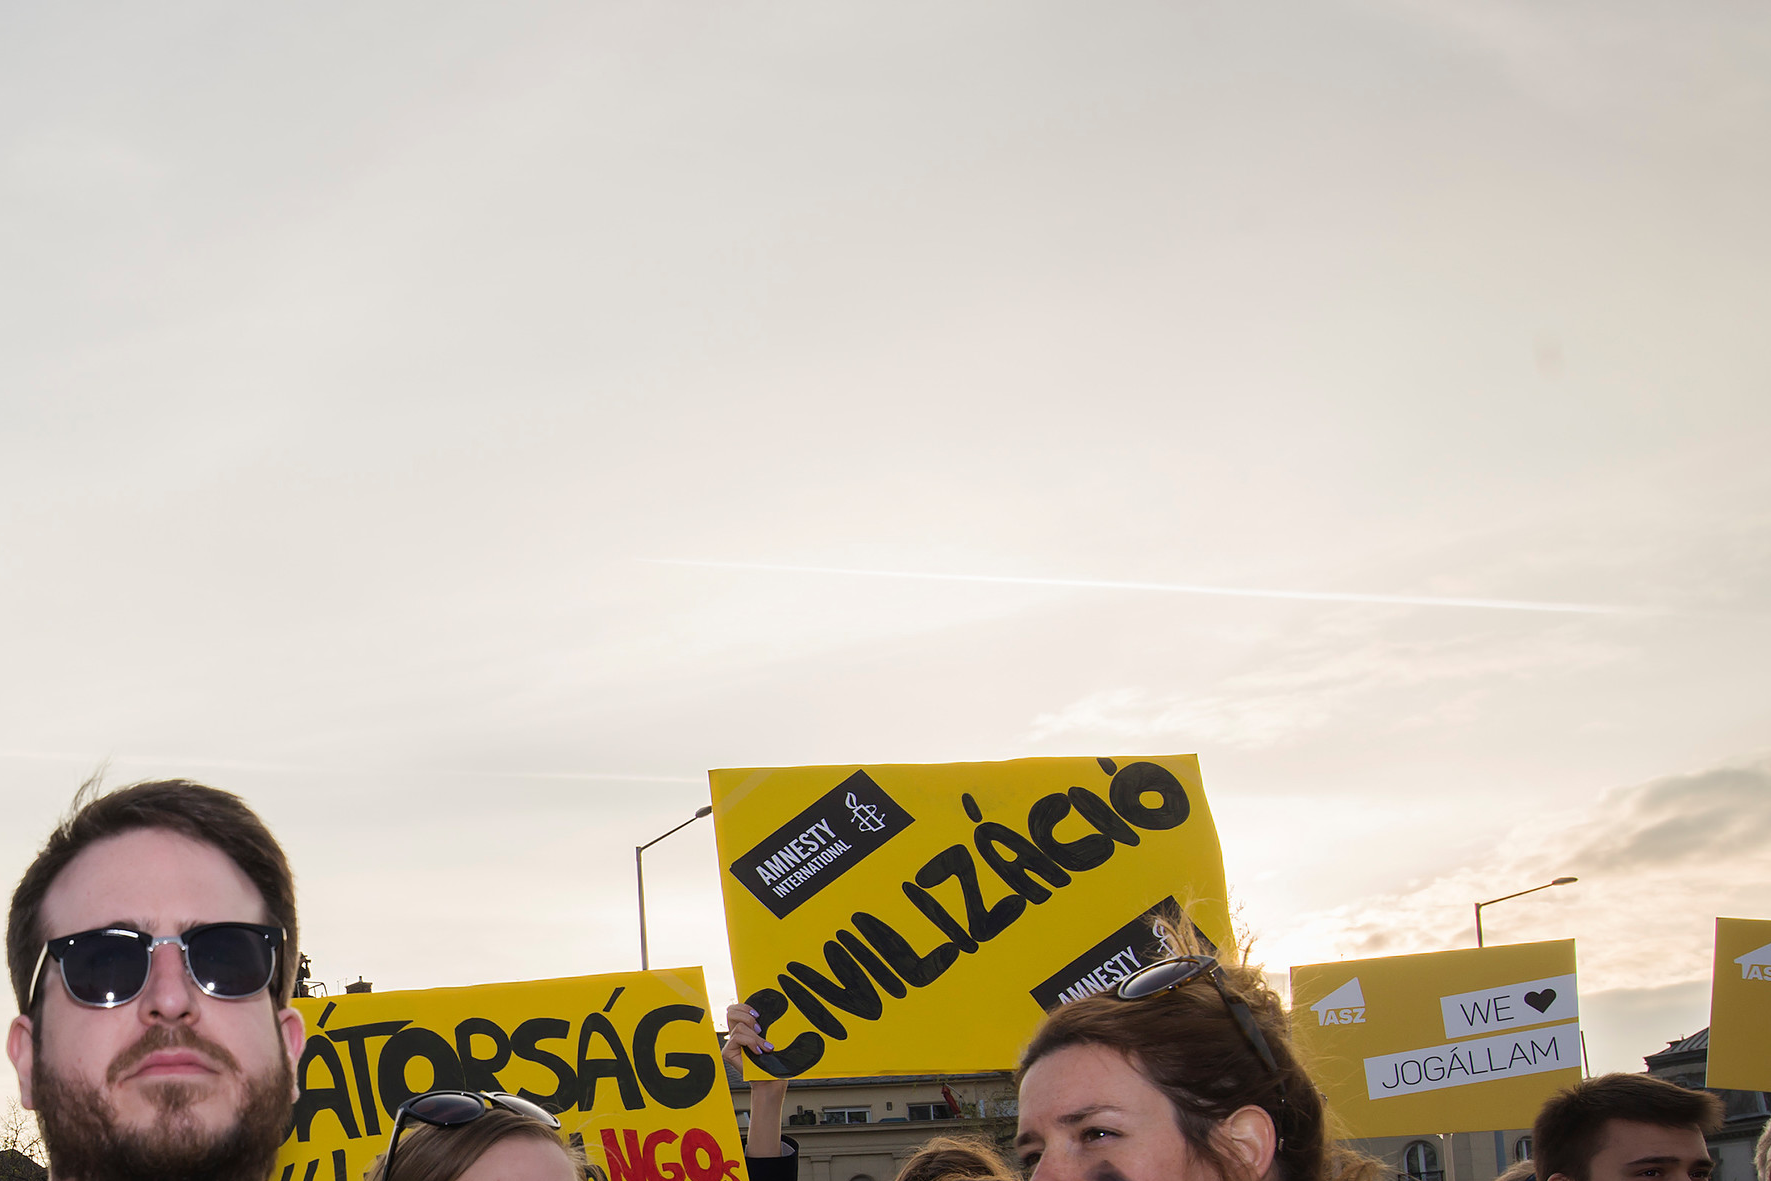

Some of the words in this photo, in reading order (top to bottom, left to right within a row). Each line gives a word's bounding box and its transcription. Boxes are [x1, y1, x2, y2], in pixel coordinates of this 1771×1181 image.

[755, 818, 837, 886] AMNESTY
[772, 839, 853, 899] INTERNATIONAL
[741, 757, 1191, 1080] CIVILIZÁCIÓ
[1310, 976, 1366, 1026] TASZ
[1460, 995, 1515, 1027] WE
[278, 986, 717, 1148] ÁTORSÁG
[1382, 1036, 1560, 1090] JOGÁLLAM
